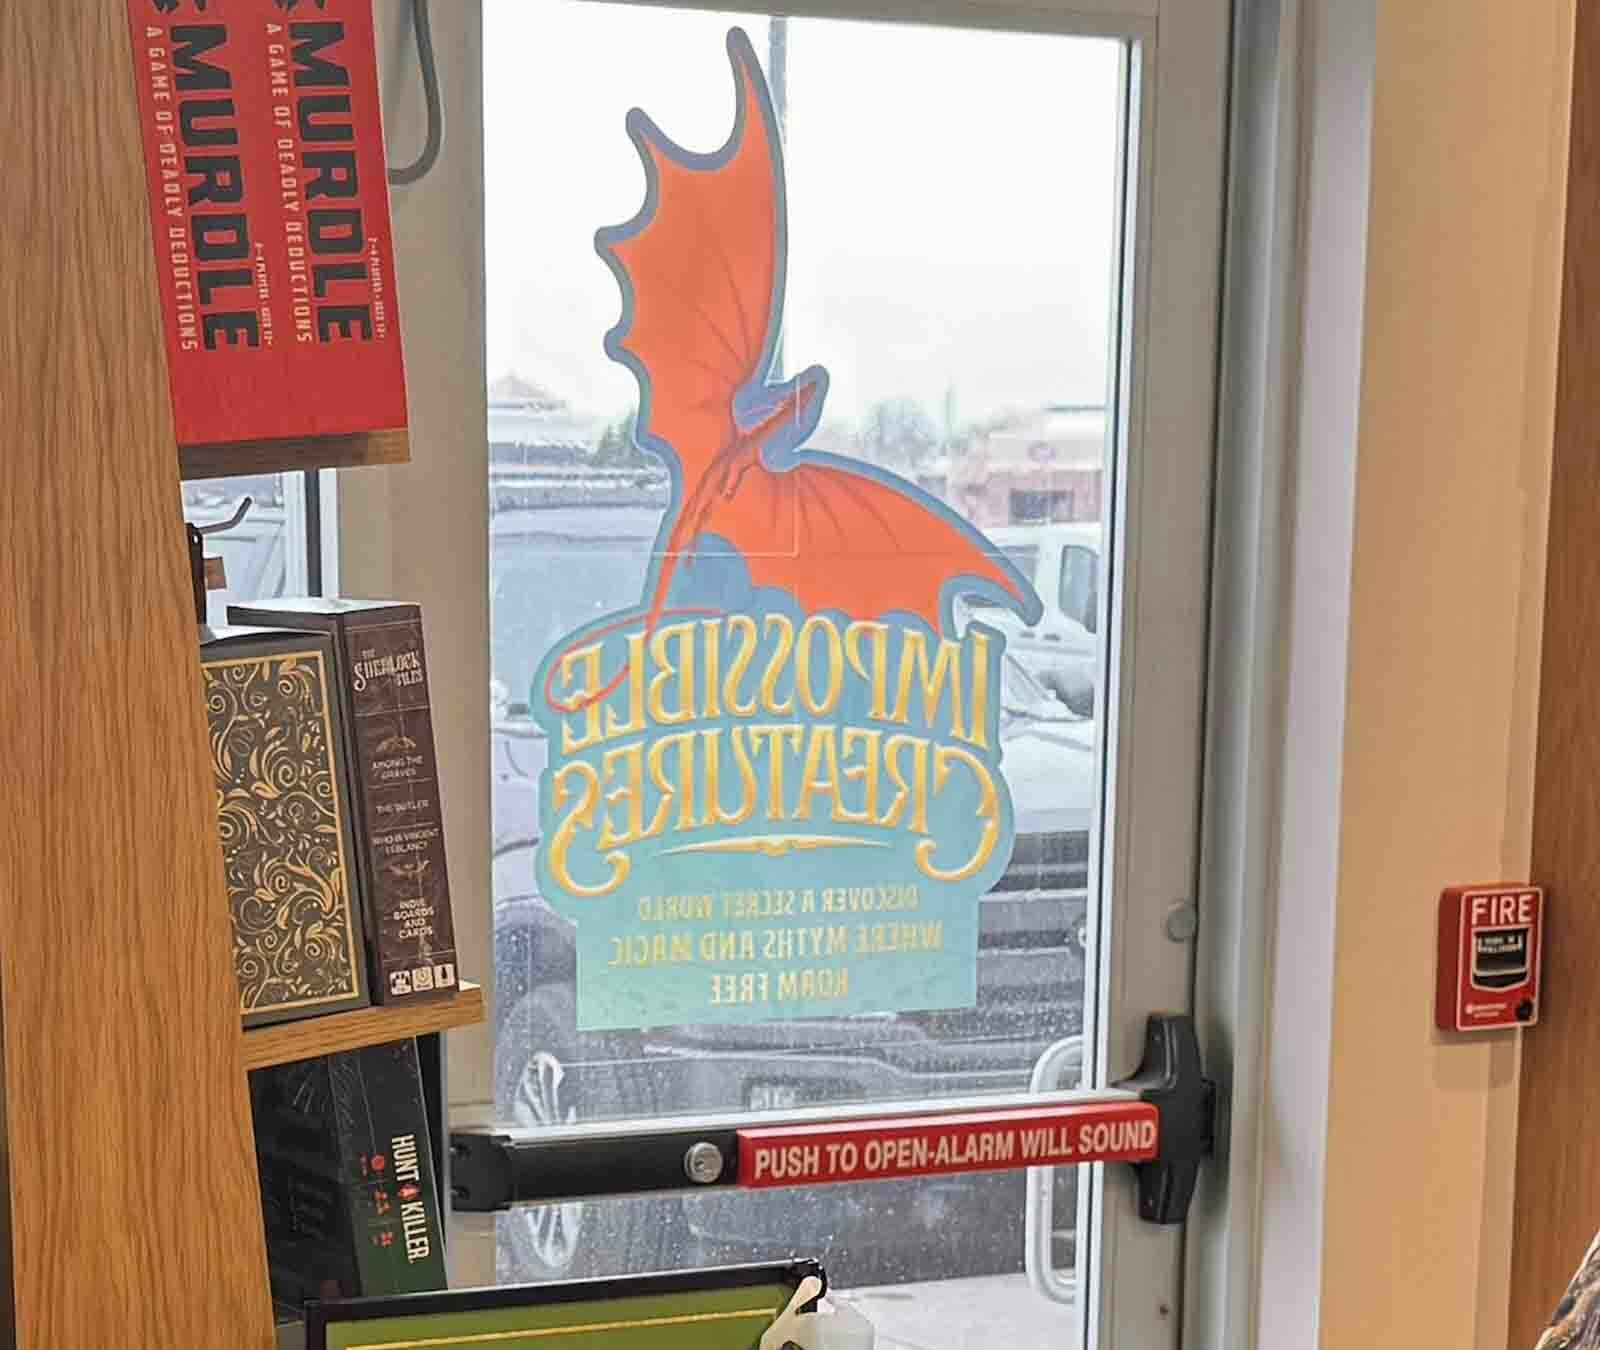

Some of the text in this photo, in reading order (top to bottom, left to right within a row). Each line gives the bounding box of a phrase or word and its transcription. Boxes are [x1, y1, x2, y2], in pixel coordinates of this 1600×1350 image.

[146, 26, 198, 352] A GAME OF DEADLY DEDUCTIONS
[170, 24, 260, 351] MURDLE
[266, 23, 313, 343] A GAME OF DEADLY DEDUCTIONS
[289, 22, 372, 343] MURDLE
[353, 649, 421, 692] SHERLOCK
[1472, 894, 1534, 926] FIRE
[391, 1133, 420, 1183] HUNT
[754, 1119, 1155, 1180] PUSH TO OPEN-ALARM WILL SOUND
